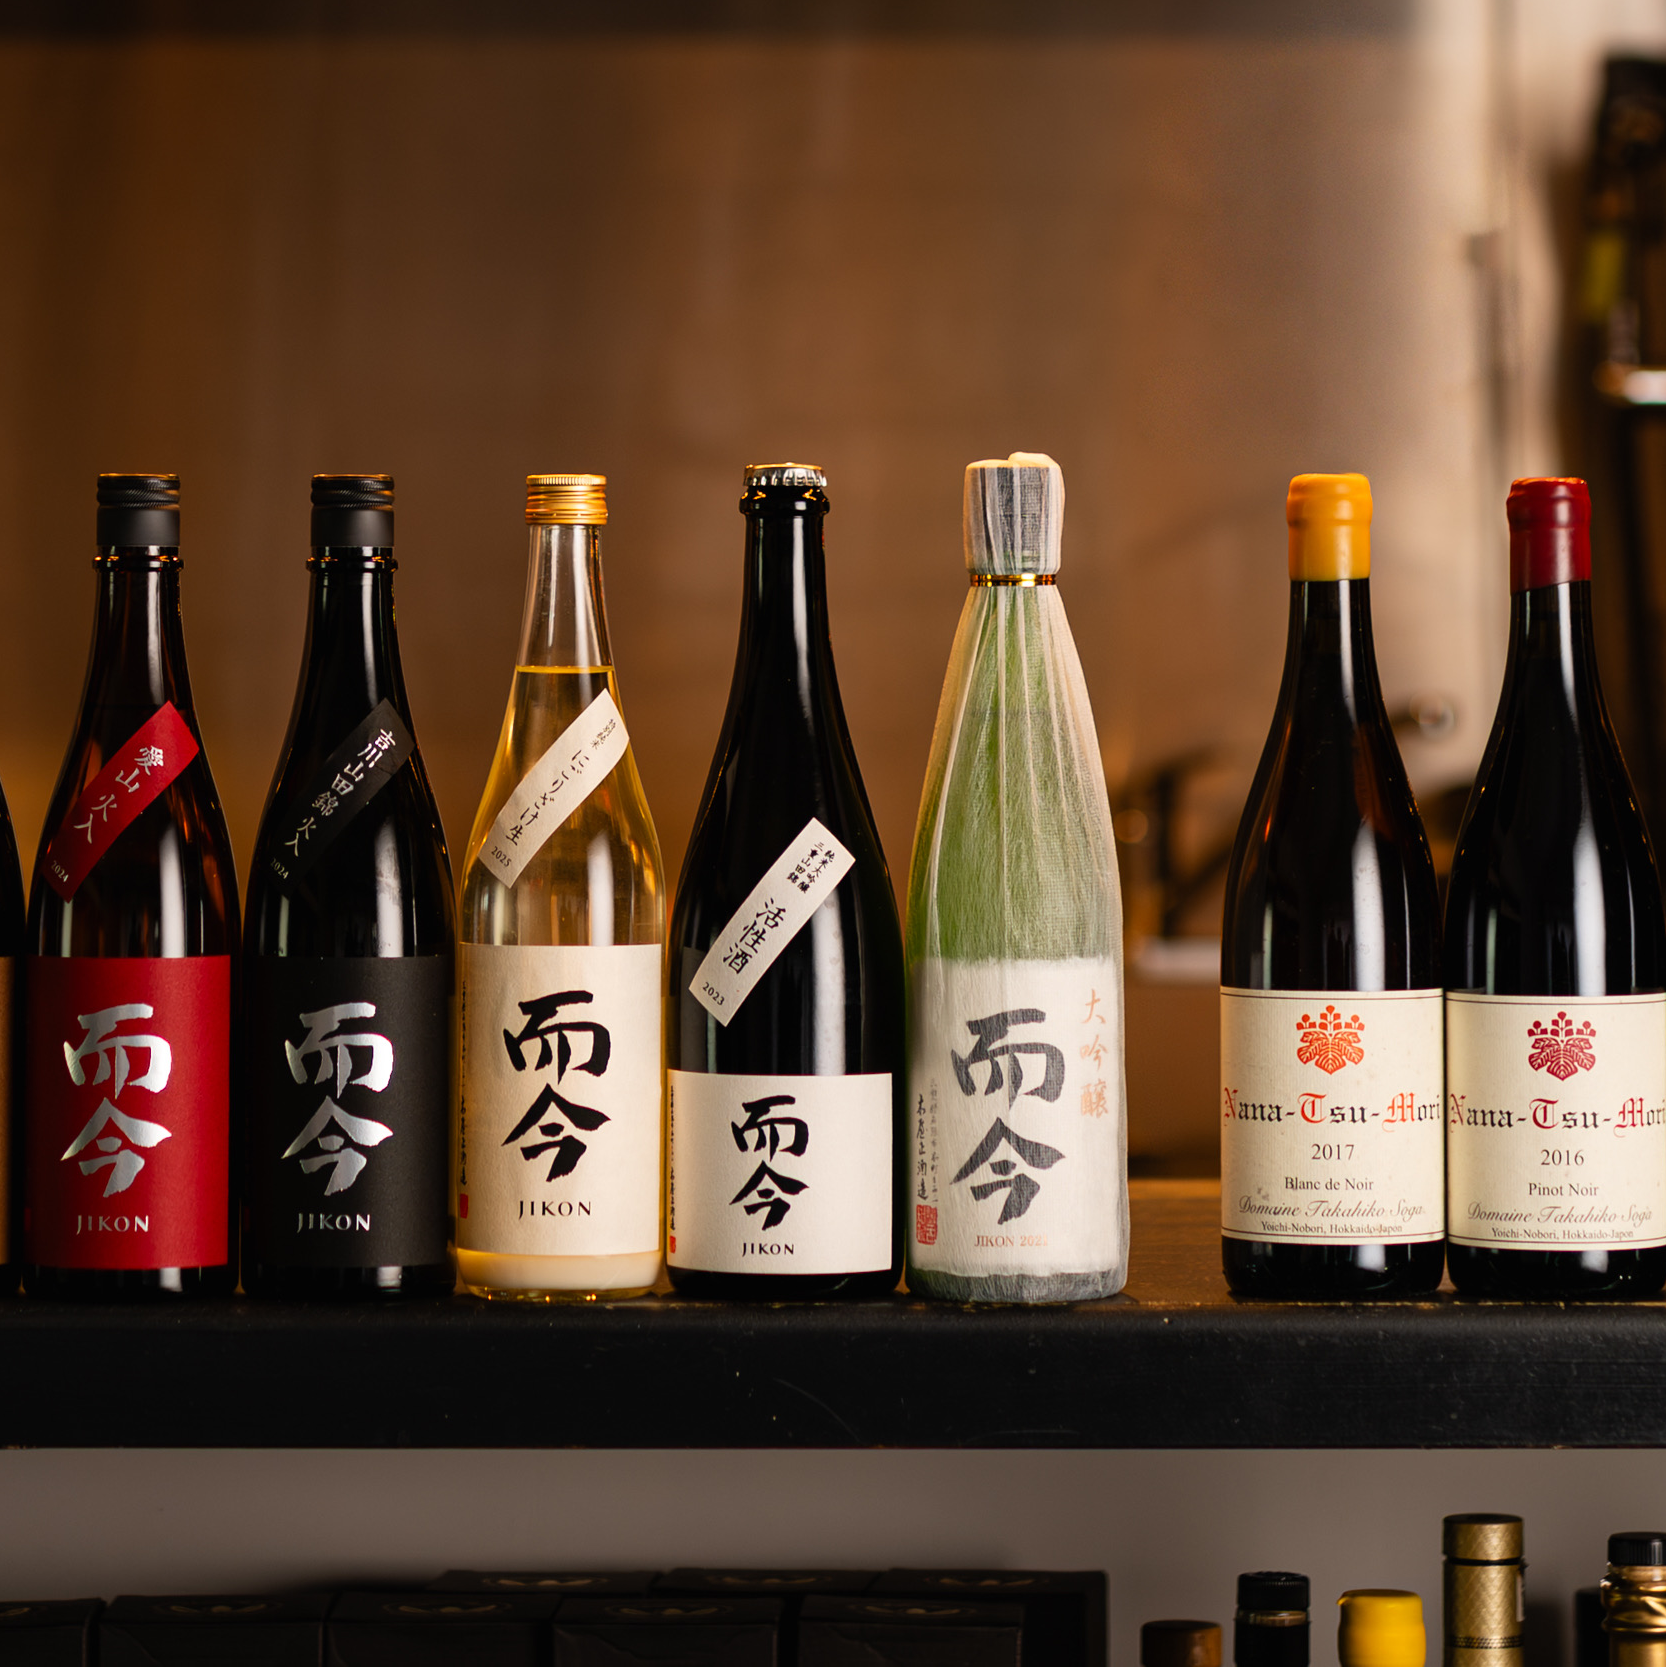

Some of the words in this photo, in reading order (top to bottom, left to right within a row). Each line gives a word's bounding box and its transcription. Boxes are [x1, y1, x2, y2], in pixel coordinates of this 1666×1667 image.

[115, 745, 164, 793] 愛山
[312, 729, 396, 816] 吉川山田錦
[74, 794, 117, 844] 火入
[285, 817, 316, 857] 火入
[271, 858, 289, 879] 2024
[491, 846, 512, 867] 2025
[51, 860, 69, 882] 2024
[723, 898, 786, 974] 活性酒
[702, 982, 725, 1006] 2023
[1080, 989, 1109, 1119] 大吟醸
[60, 1002, 172, 1197] 而今
[280, 1001, 394, 1196] 而今
[501, 990, 611, 1182] 而今
[949, 1008, 1066, 1225] 而今
[1224, 1087, 1440, 1132] Nana-Tsu-Mori
[728, 1094, 809, 1231] 而今
[1311, 1144, 1354, 1160] 2017
[1541, 1149, 1584, 1166] 2016
[1285, 1177, 1320, 1190] Blanc
[1325, 1178, 1339, 1190] de
[1345, 1179, 1373, 1190] Noir
[1528, 1183, 1563, 1196] Pinot
[1569, 1183, 1599, 1196] Noir
[518, 1200, 592, 1219] JIKON
[1239, 1195, 1300, 1216] Domaine
[1305, 1200, 1384, 1217] Takahiko
[1390, 1199, 1423, 1222] Soga
[1467, 1201, 1533, 1223] Domaine
[1537, 1206, 1617, 1223] Takahiko
[1621, 1204, 1652, 1228] Soga
[75, 1214, 149, 1234] JIKON
[296, 1213, 370, 1233] JIKON
[740, 1242, 794, 1258] JIKON
[974, 1234, 1015, 1247] JIKON
